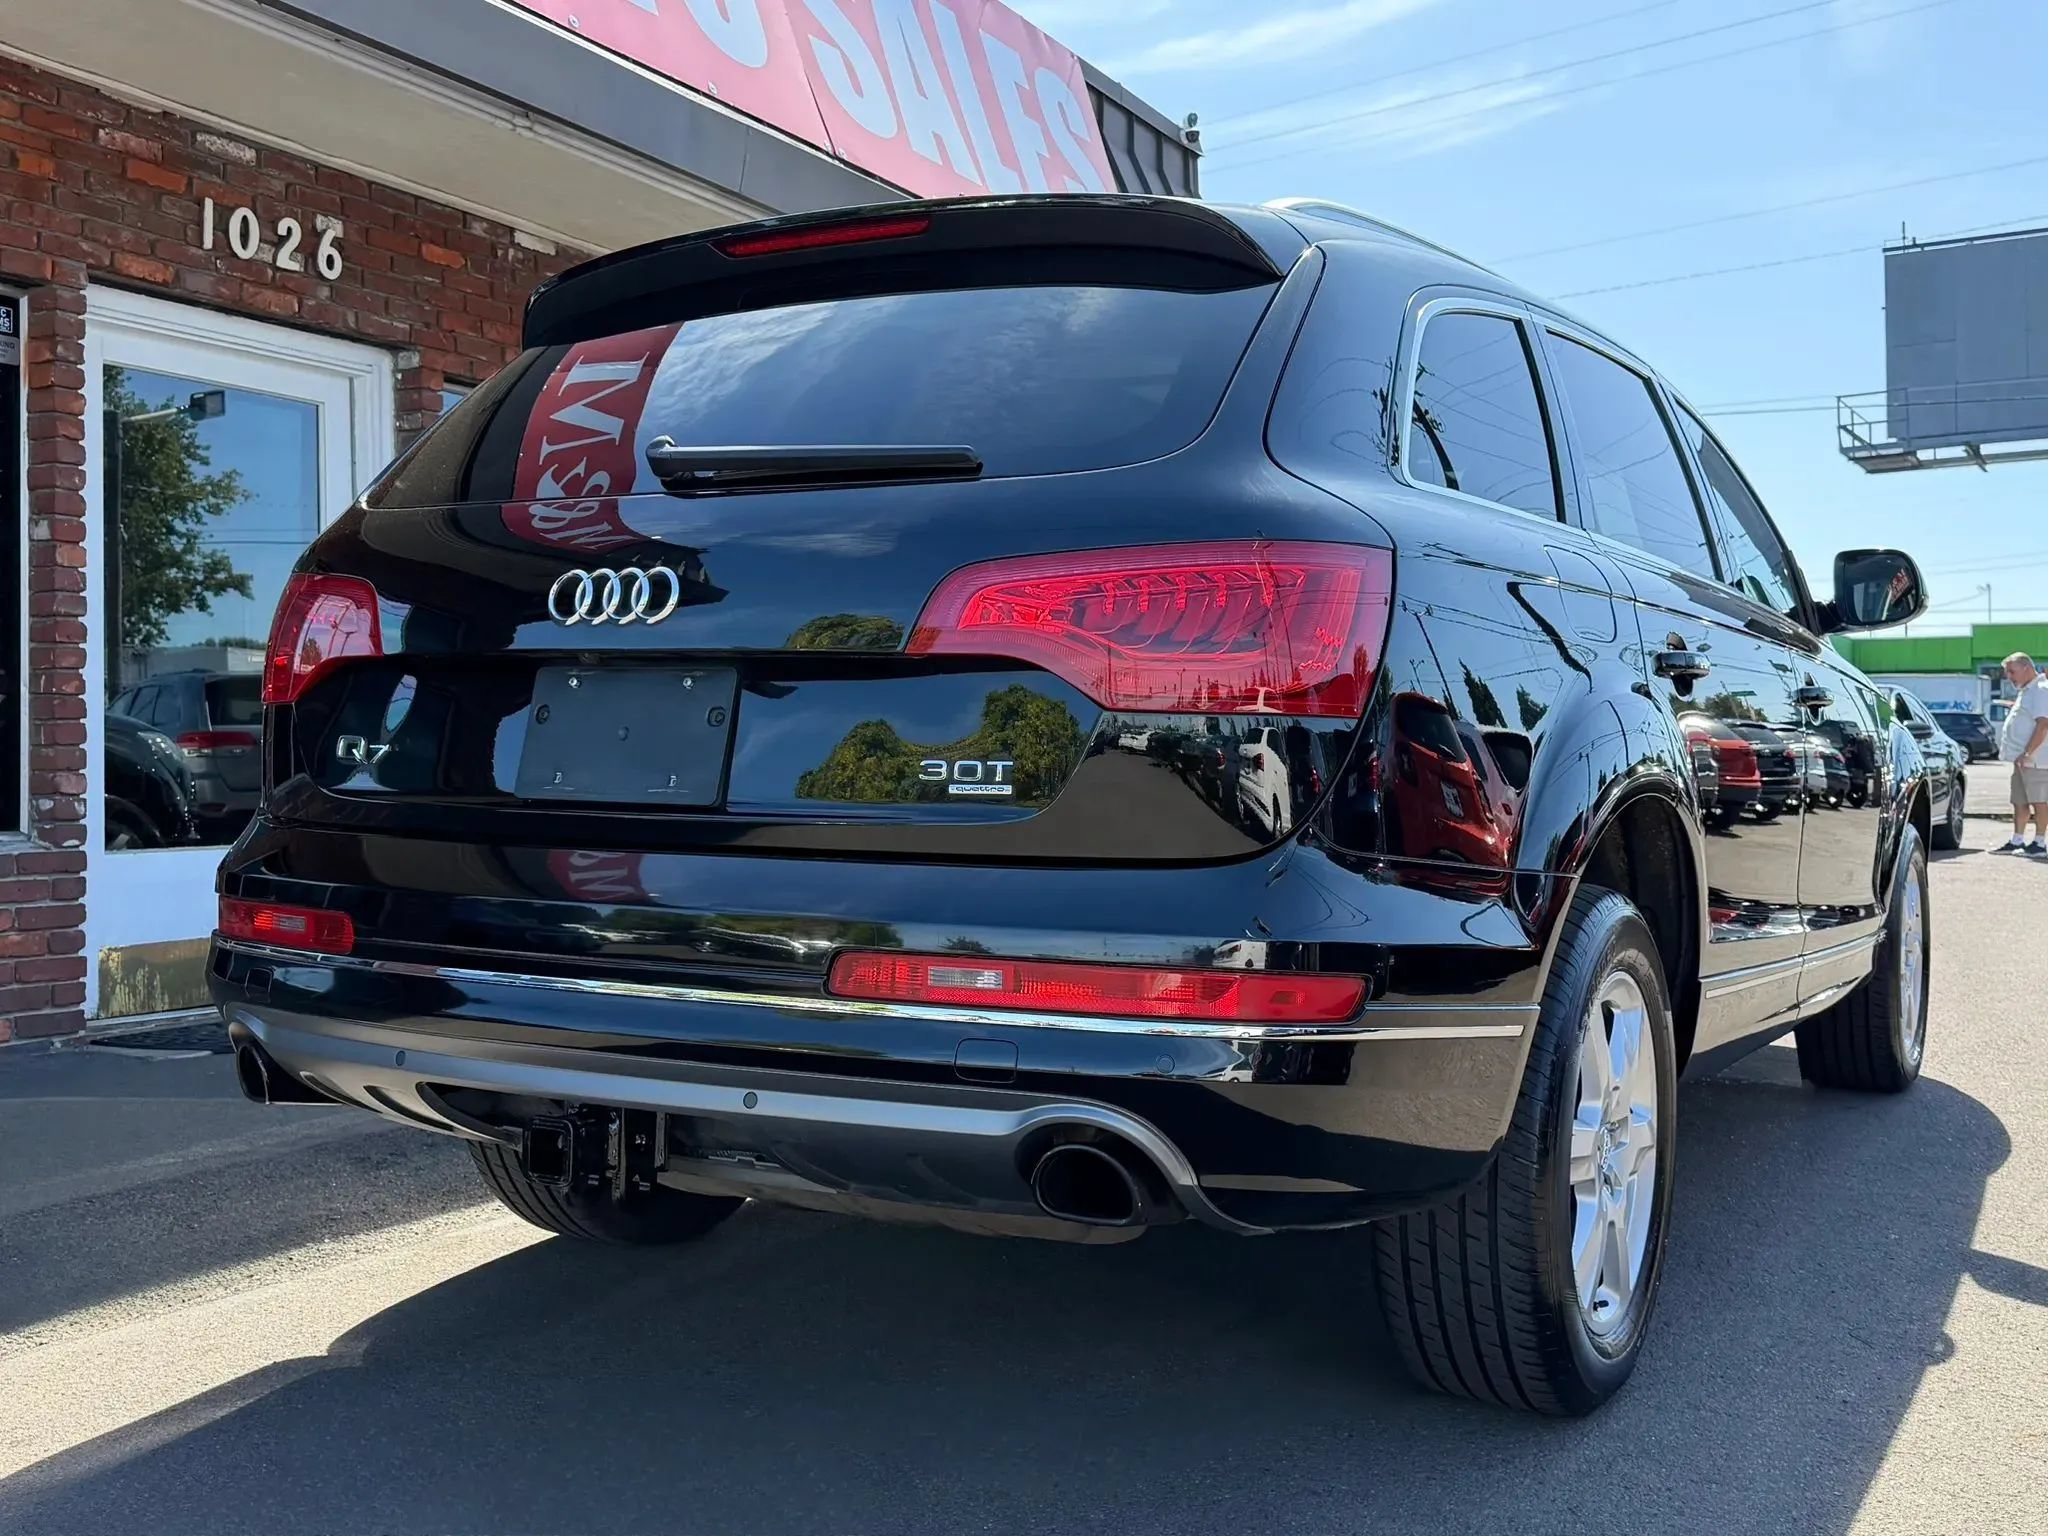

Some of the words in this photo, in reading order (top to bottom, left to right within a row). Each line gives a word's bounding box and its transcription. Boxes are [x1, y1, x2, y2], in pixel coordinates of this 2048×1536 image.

[803, 0, 1106, 194] SALES
[203, 197, 344, 281] 1026
[336, 734, 391, 765] Q7
[955, 785, 1006, 793] quattro
